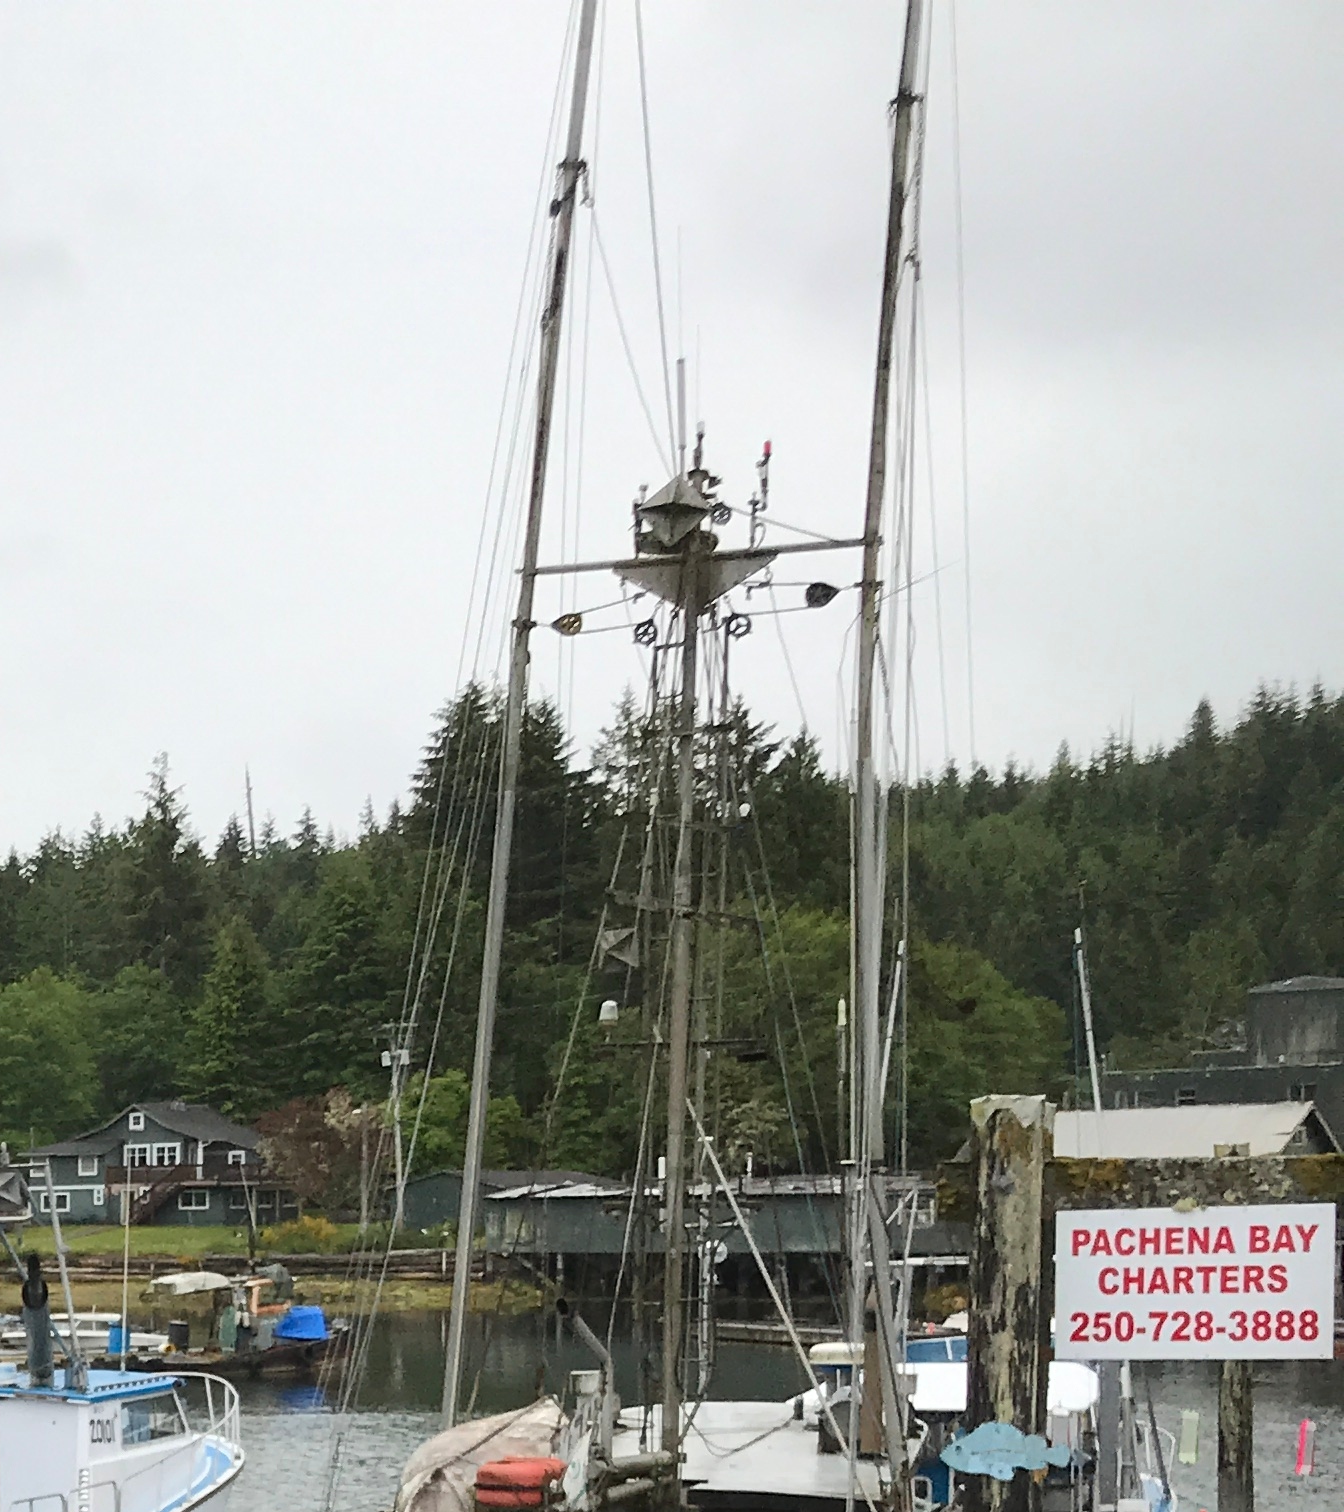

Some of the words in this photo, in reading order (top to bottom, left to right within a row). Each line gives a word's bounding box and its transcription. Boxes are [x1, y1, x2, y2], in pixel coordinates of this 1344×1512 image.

[1071, 1226, 1236, 1257] PACHENA
[1249, 1224, 1320, 1254] BAY
[1097, 1265, 1289, 1296] CHARTERS
[1069, 1309, 1320, 1343] 250-728-3888
